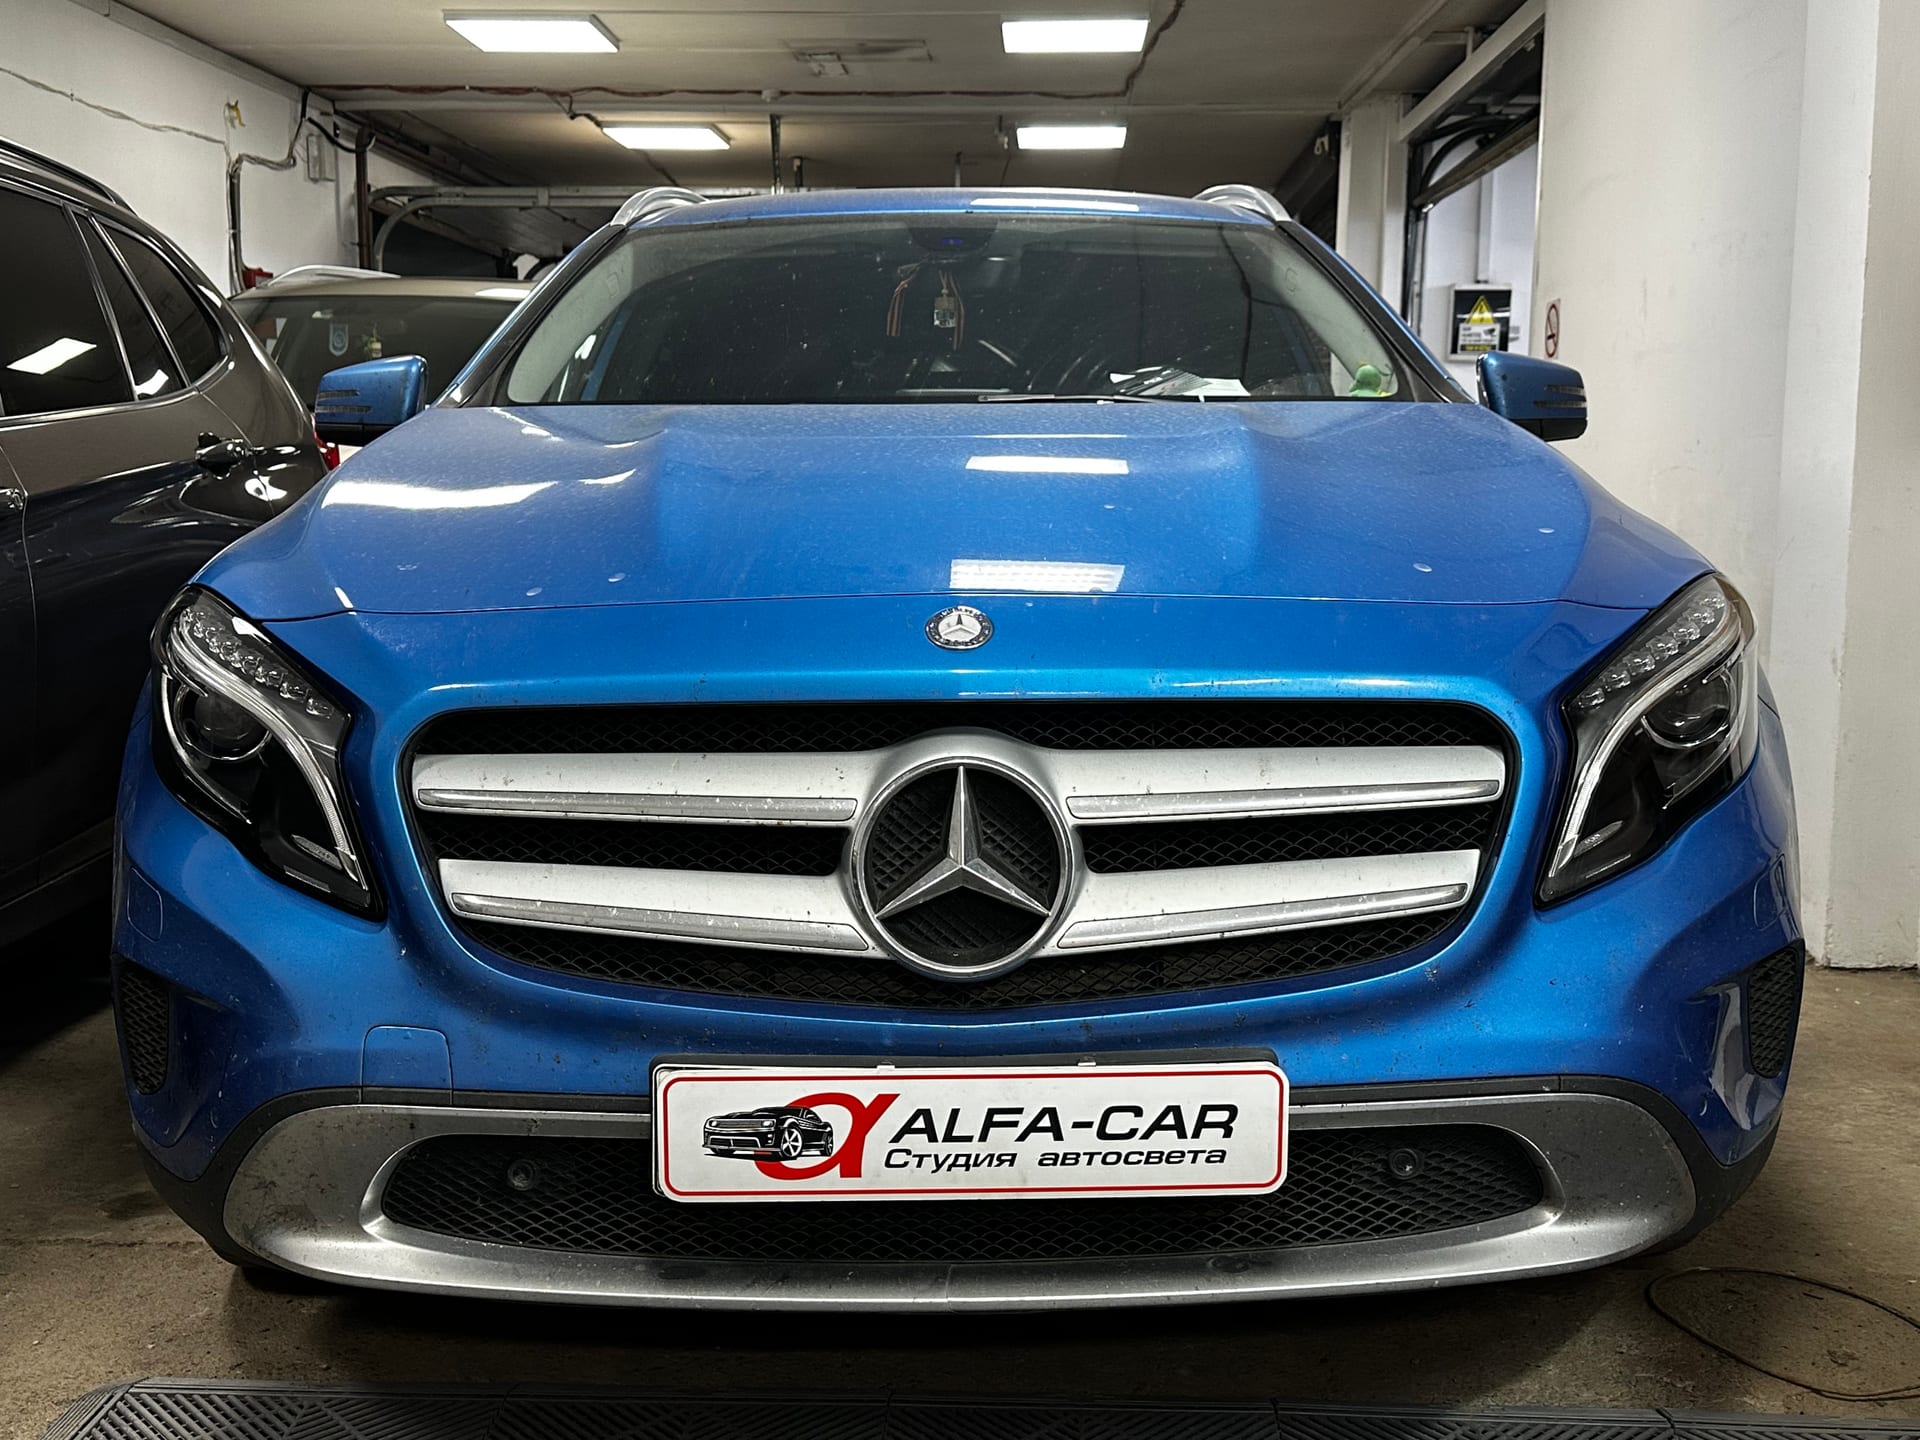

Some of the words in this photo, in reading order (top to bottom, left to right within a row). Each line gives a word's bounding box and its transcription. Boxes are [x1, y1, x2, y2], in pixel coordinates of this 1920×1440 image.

[888, 1104, 1239, 1144] ALFA-CAR
[884, 1148, 1018, 1174] Студия
[1038, 1149, 1227, 1167] автосвета
